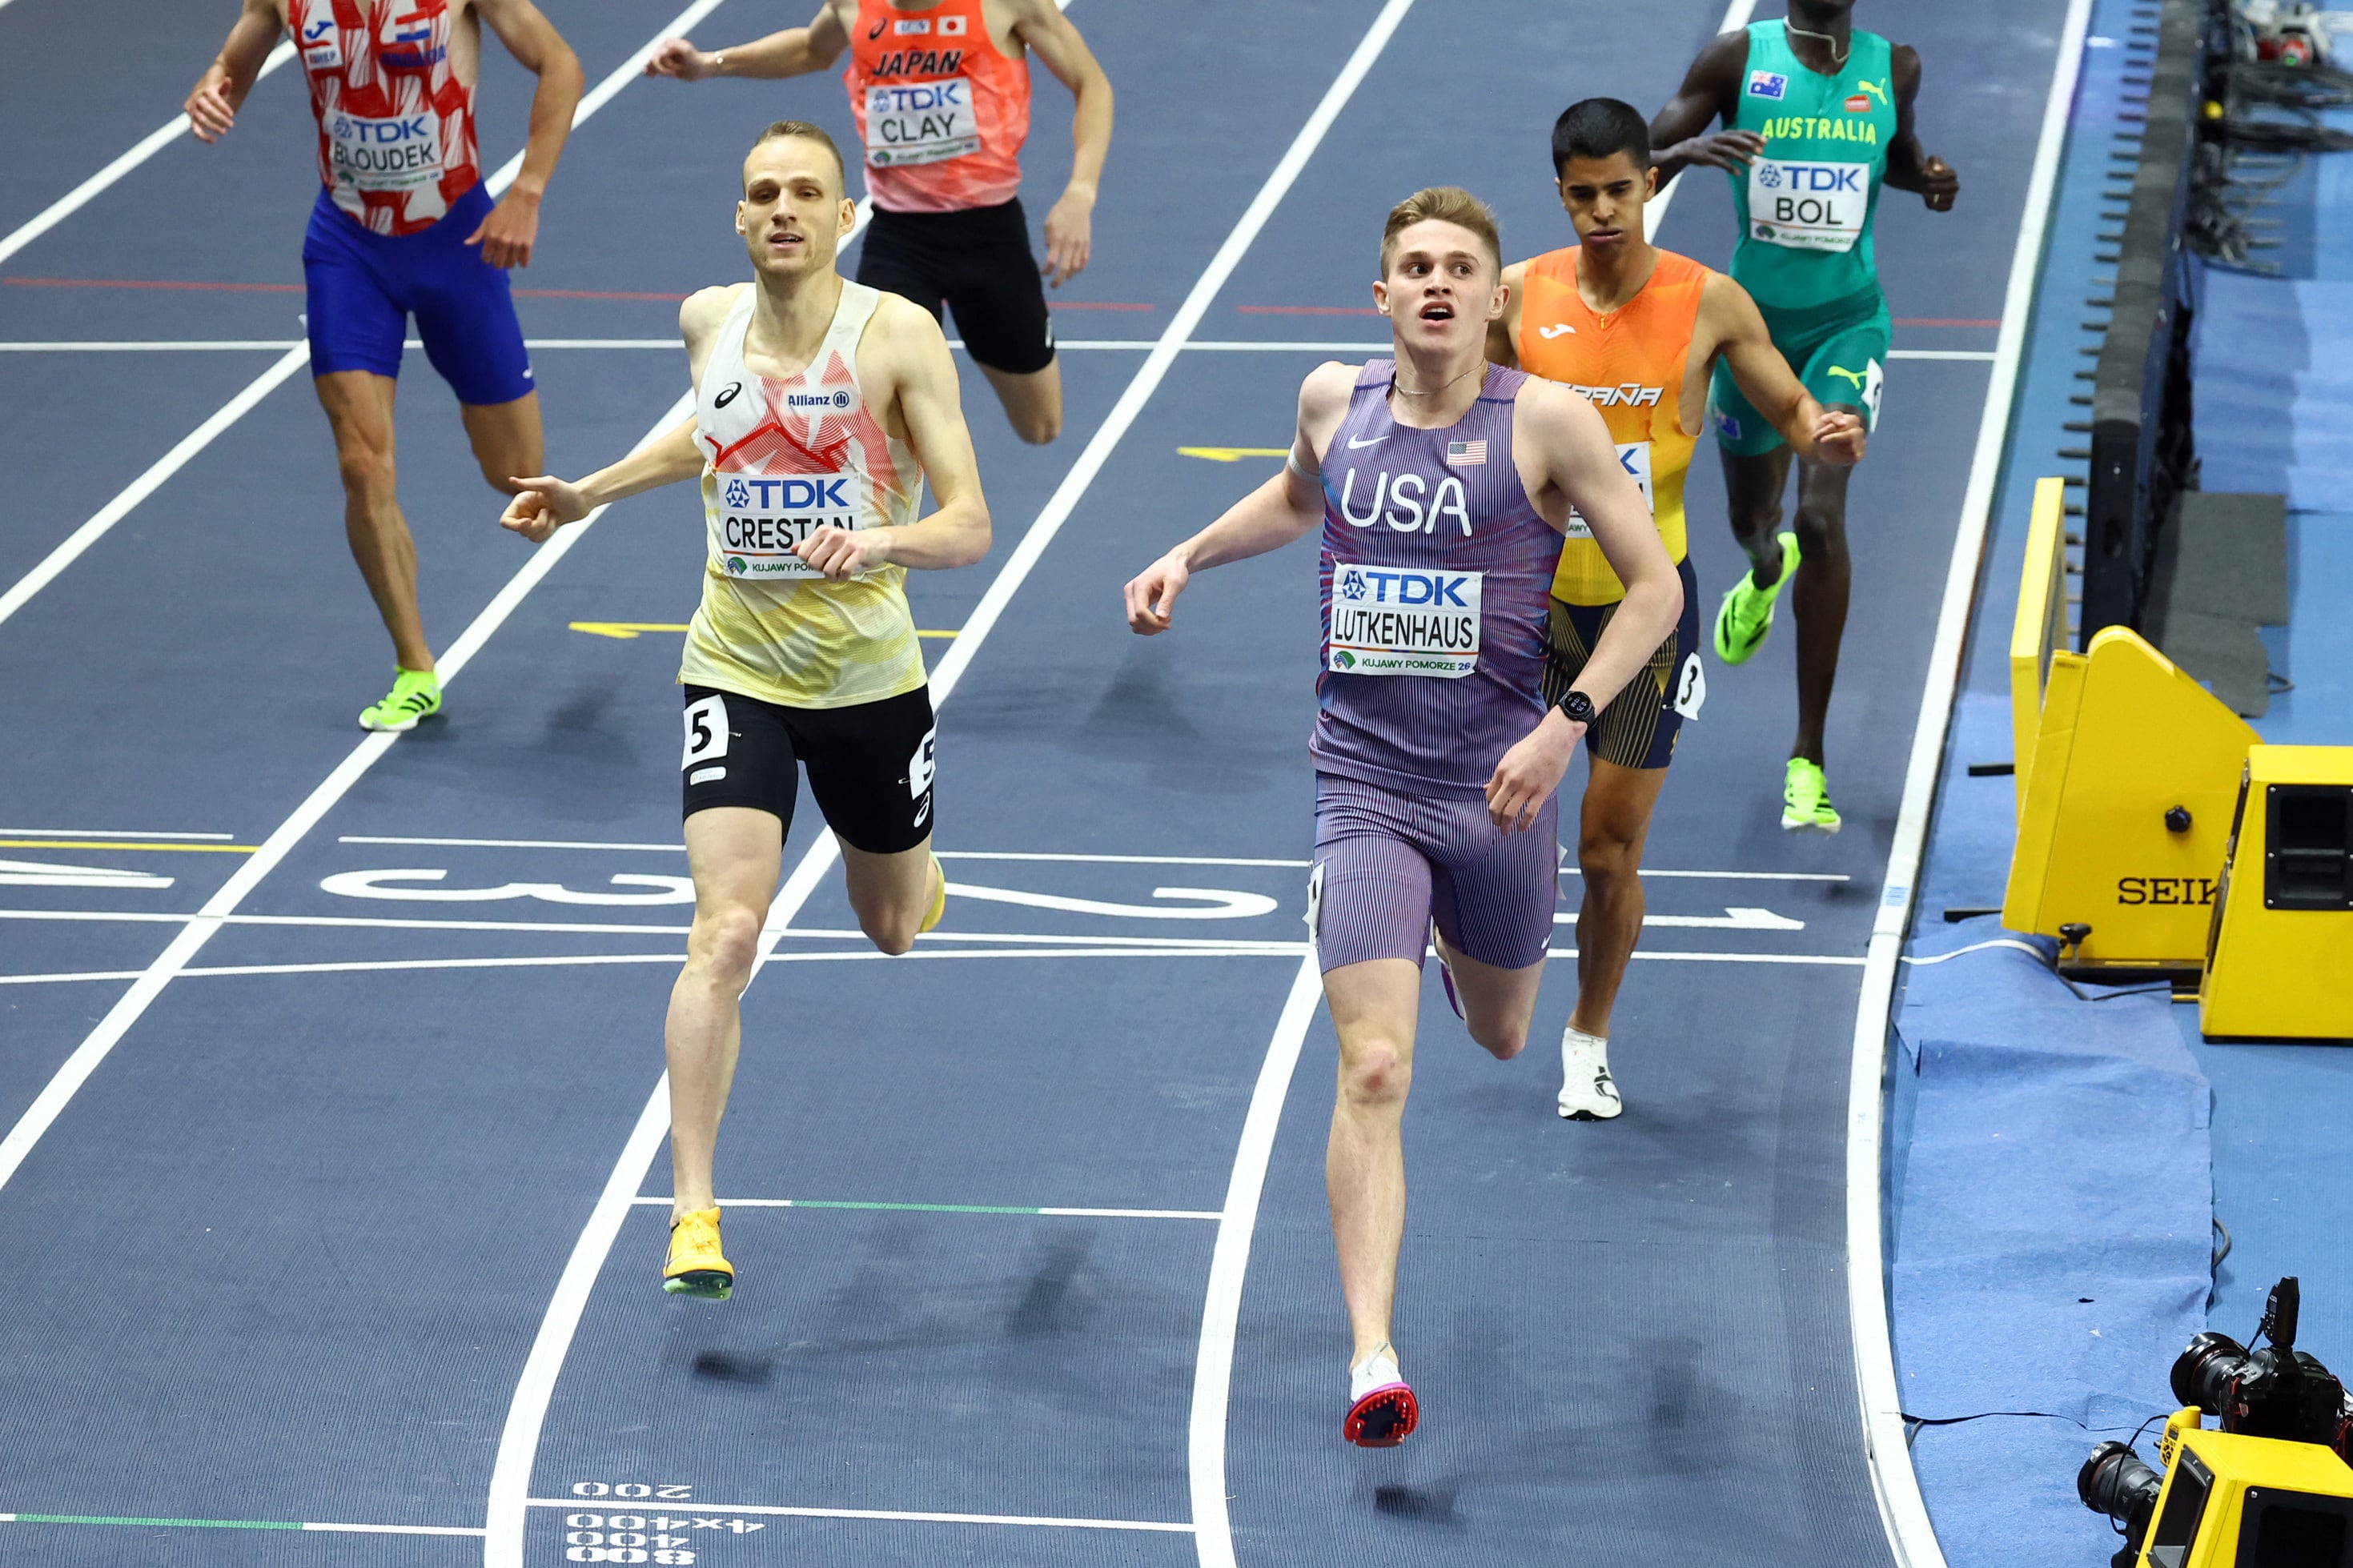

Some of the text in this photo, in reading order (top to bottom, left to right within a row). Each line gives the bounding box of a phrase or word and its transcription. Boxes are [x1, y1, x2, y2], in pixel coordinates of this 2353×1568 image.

[873, 50, 962, 76] JAPAN
[891, 82, 961, 111] TDK
[352, 116, 428, 142] TDK
[881, 113, 955, 142] CLAY
[1762, 117, 1877, 145] AUSTRALIA
[333, 142, 436, 170] BLOUDEK
[1782, 166, 1861, 191] TDK
[1776, 197, 1843, 225] BOL
[789, 395, 830, 406] Allianz
[749, 479, 850, 509] TDK
[1341, 468, 1472, 536] USA
[753, 563, 792, 571] KUJAWY
[1366, 571, 1468, 607] TDK
[1335, 608, 1473, 648] LUTKENHAUS
[1363, 658, 1403, 668] KUJAWY
[1406, 660, 1456, 670] POMORZE
[1680, 664, 1698, 705] 3
[691, 709, 712, 754] 5
[923, 736, 934, 781] 5
[320, 868, 697, 905] 3
[572, 1482, 693, 1499] 200
[566, 1531, 689, 1548] 400
[566, 1546, 696, 1565] 800
